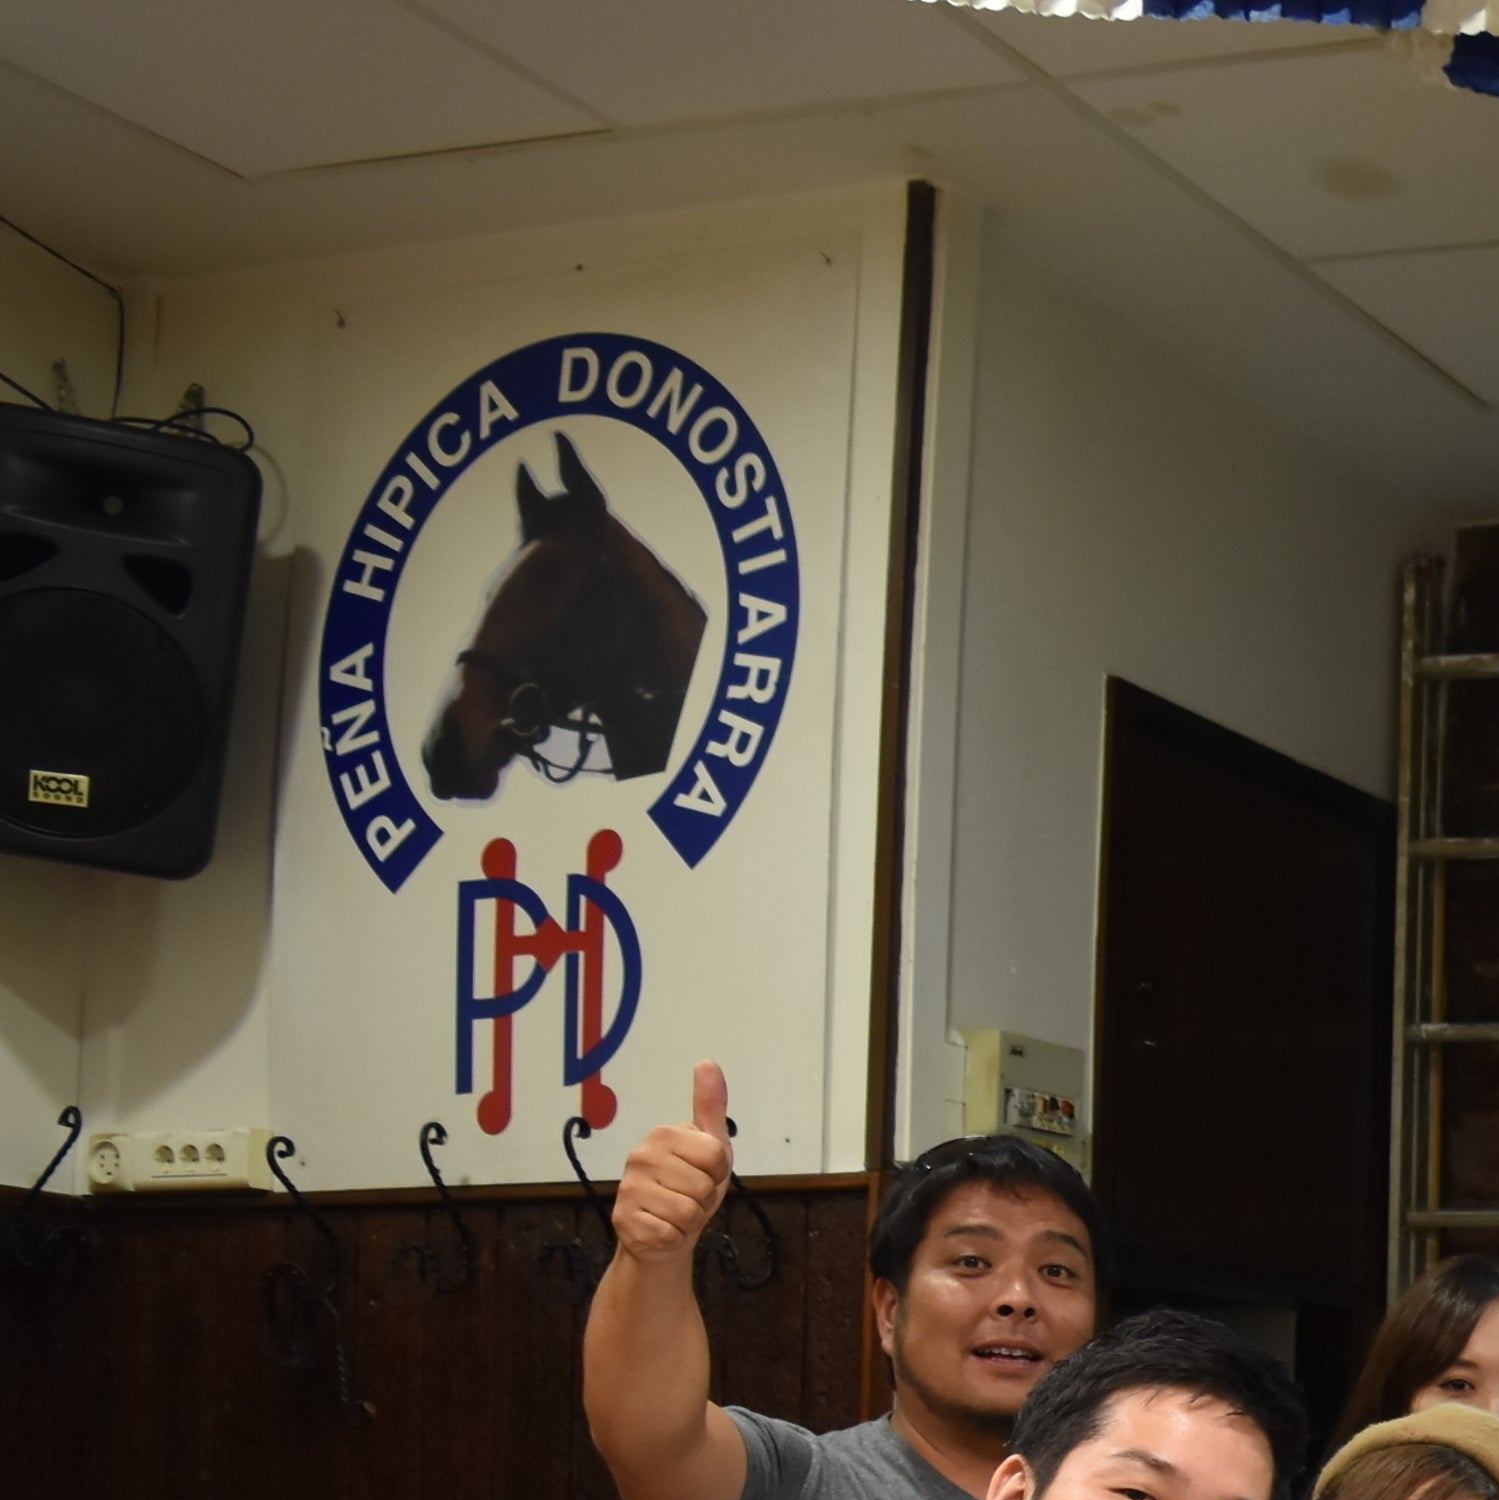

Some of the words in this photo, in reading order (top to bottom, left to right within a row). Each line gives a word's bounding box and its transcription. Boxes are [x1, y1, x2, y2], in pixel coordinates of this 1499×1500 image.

[342, 379, 520, 603] HIPICA
[557, 345, 787, 820] DONOSTIARRA
[33, 774, 83, 796] KOOL
[320, 642, 416, 863] PEÑA
